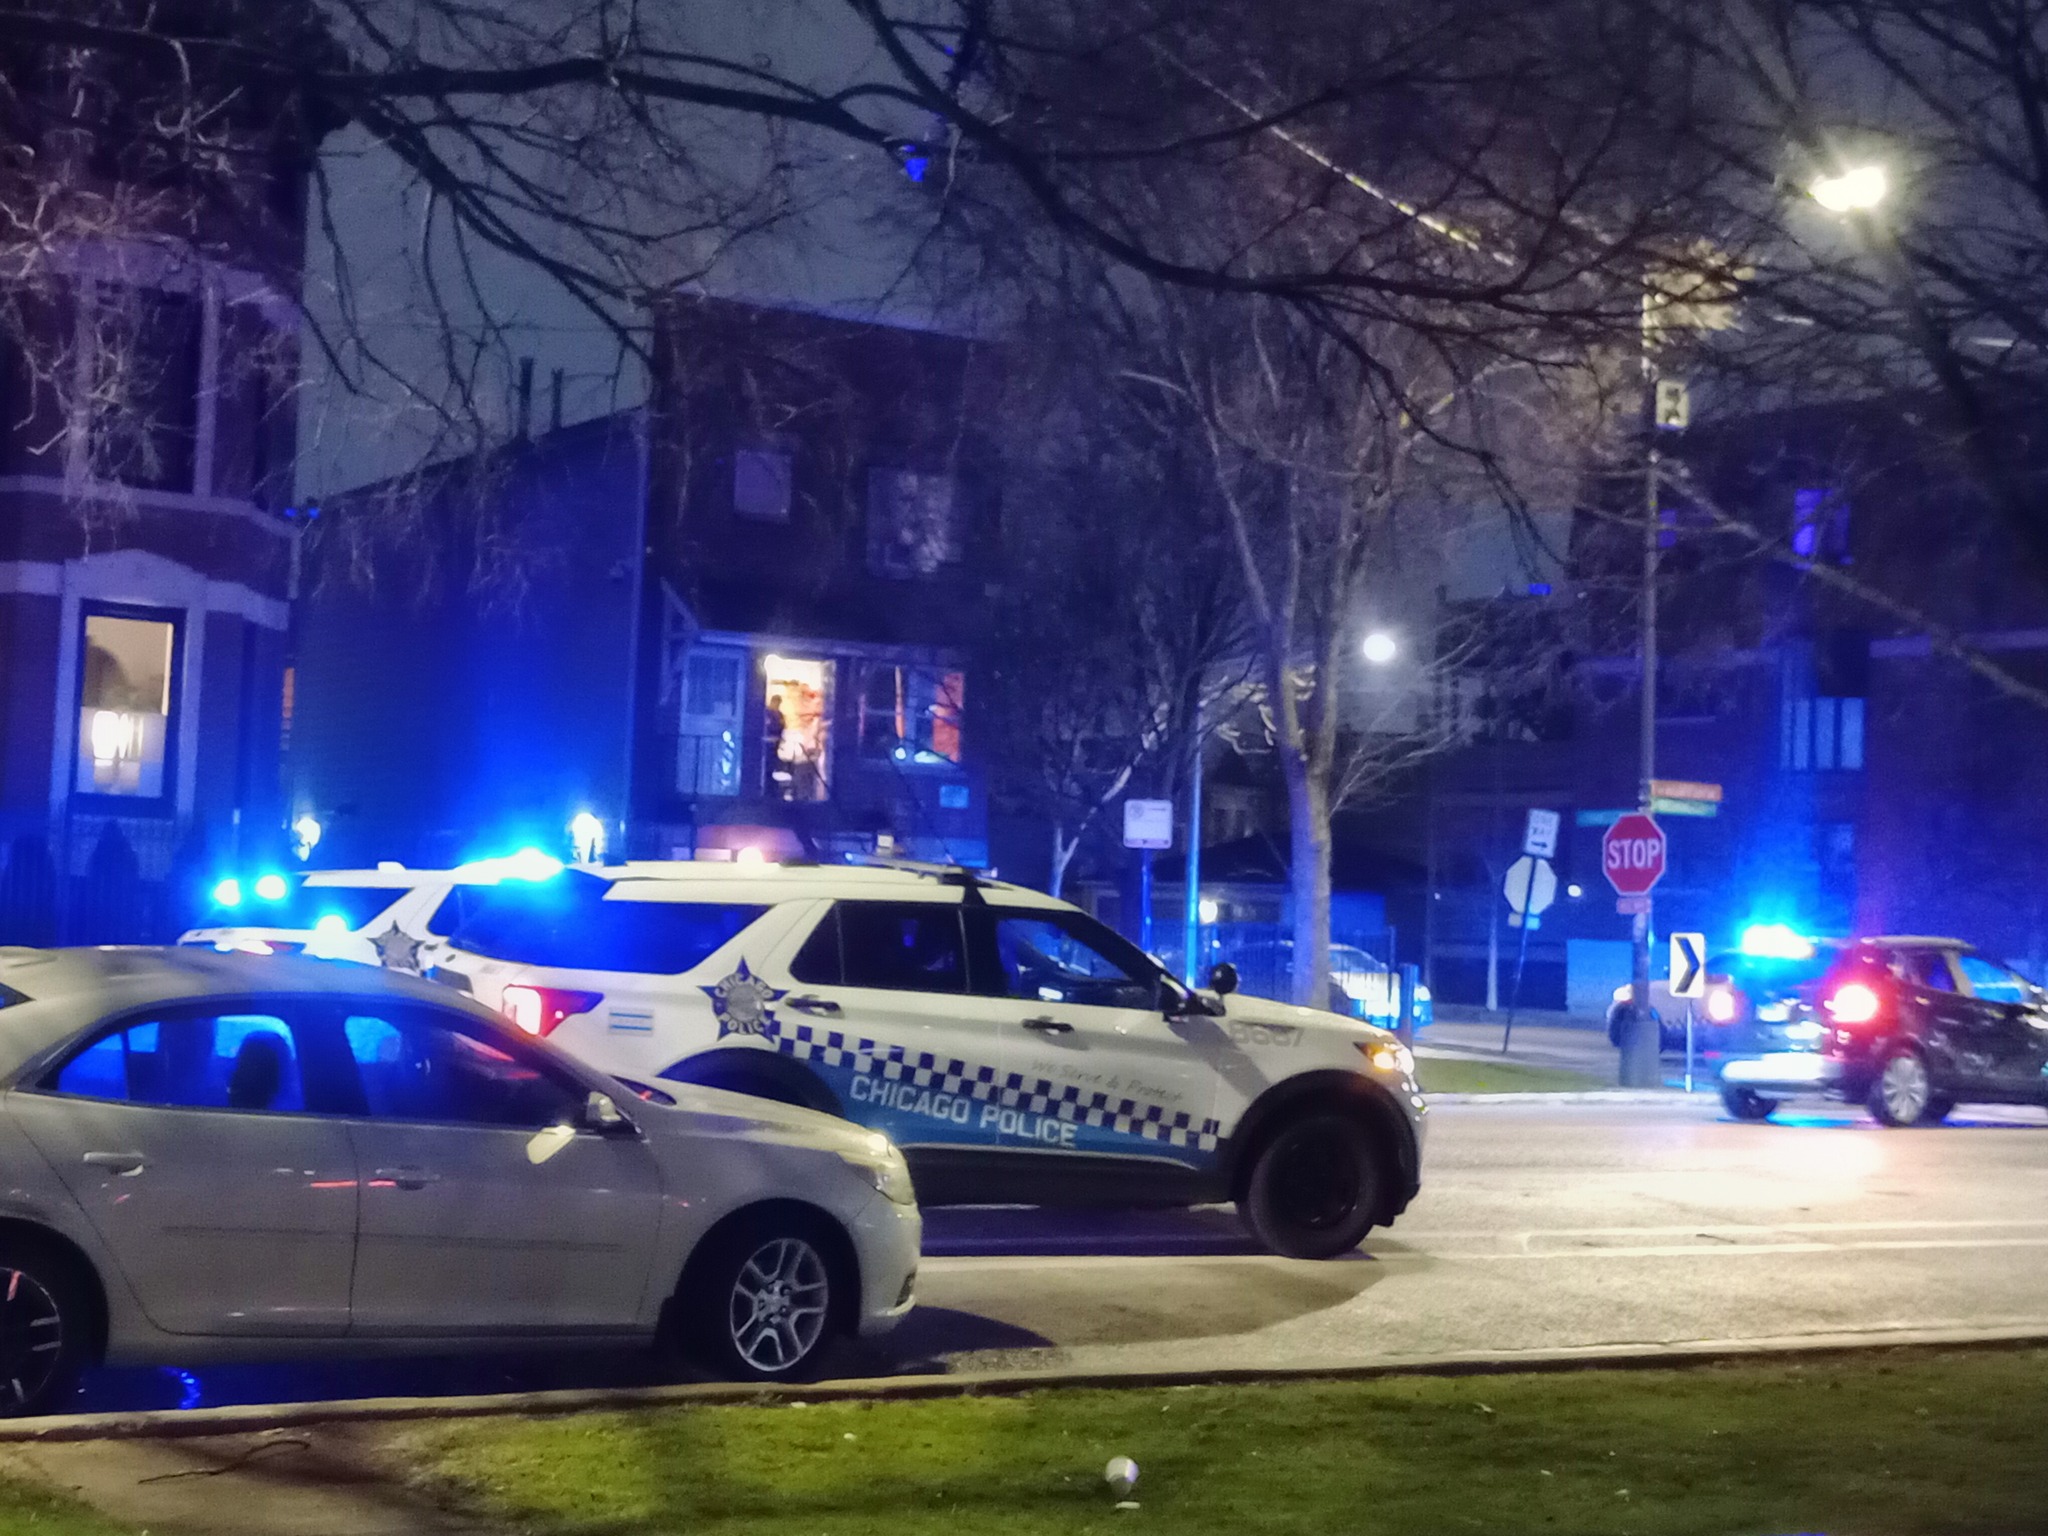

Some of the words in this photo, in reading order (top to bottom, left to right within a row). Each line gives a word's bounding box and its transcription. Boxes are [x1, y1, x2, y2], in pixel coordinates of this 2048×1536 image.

[1607, 838, 1660, 870] STOP
[714, 973, 774, 999] CHICAGO
[719, 1011, 772, 1034] POLICE
[850, 1075, 971, 1124] CHICAGO
[980, 1104, 1079, 1146] POLICE
